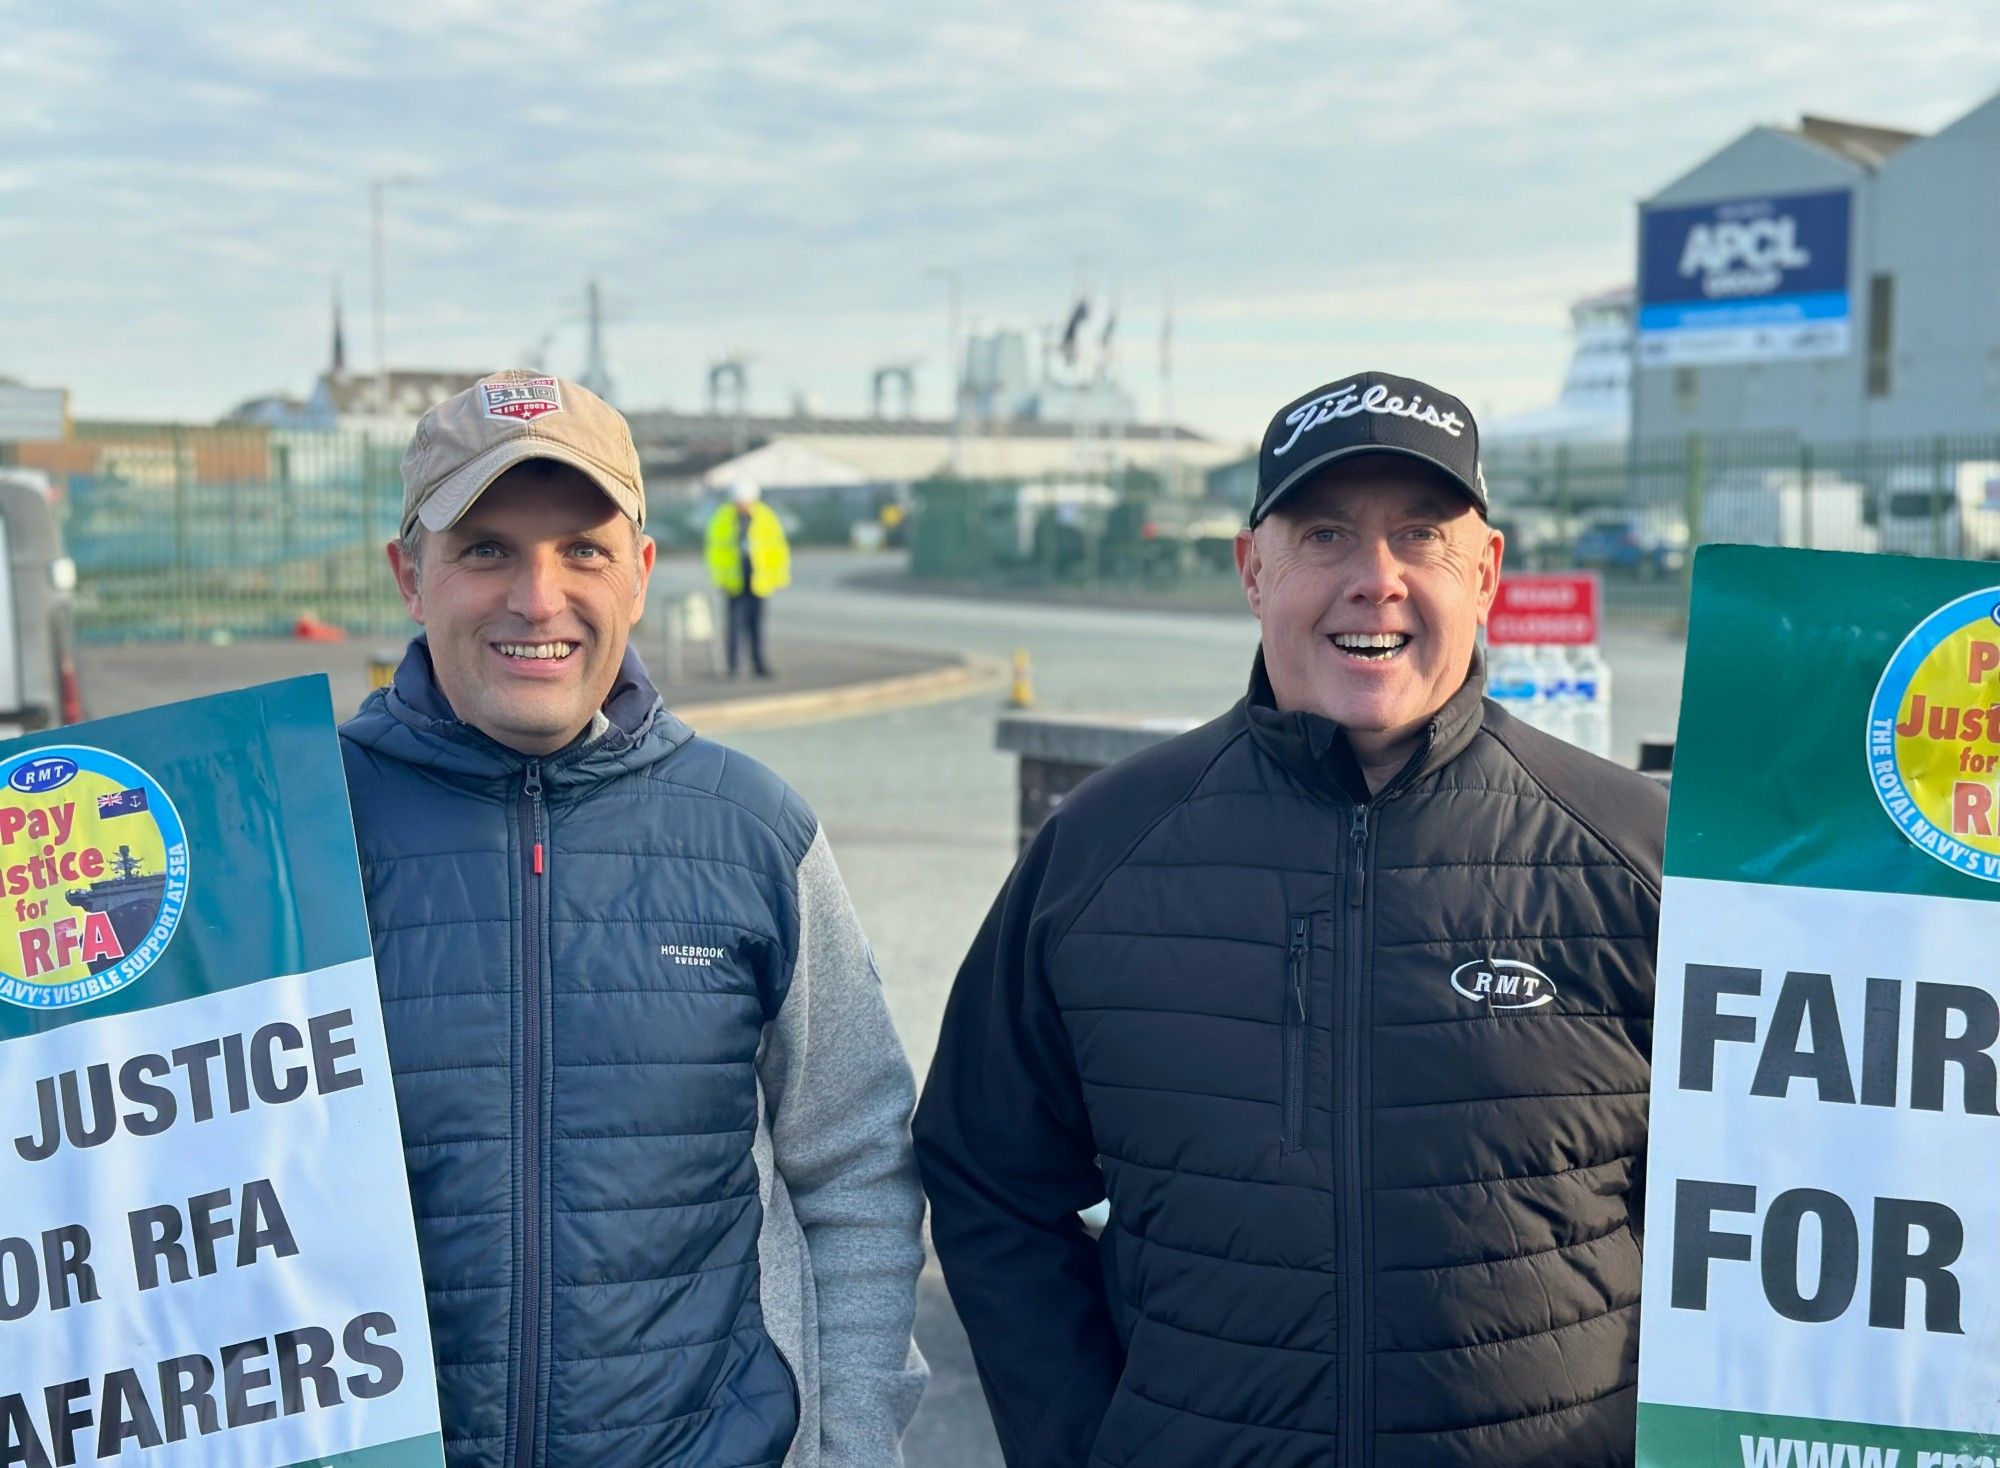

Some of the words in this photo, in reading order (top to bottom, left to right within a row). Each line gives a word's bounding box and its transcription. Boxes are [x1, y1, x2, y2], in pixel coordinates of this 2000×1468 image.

[1679, 216, 1811, 277] APCL
[490, 388, 532, 403] 5.11
[1273, 384, 1465, 457] Titleist
[1968, 640, 2000, 684] P
[1873, 718, 1893, 757] THE
[1960, 746, 1999, 773] for
[25, 765, 64, 785] RMT
[1874, 759, 1917, 825] ROYAL
[0, 802, 75, 846] Pay
[1953, 782, 2000, 836] R
[169, 842, 186, 877] SEA
[1910, 818, 1982, 871] NAVY'S
[0, 844, 104, 898] stice
[167, 880, 184, 904] AT
[16, 898, 49, 922] for
[19, 911, 125, 978] RFA
[121, 904, 178, 979] SUPPORT
[661, 945, 724, 958] HOLEBROOK
[675, 956, 711, 966] SWEDEN
[52, 968, 123, 1002] VISIBLE
[1473, 972, 1539, 996] RMT
[1679, 963, 2000, 1117] FAIR
[14, 1008, 364, 1162] JUSTICE
[128, 1178, 300, 1291] RFA
[1671, 1179, 1966, 1335] FOR
